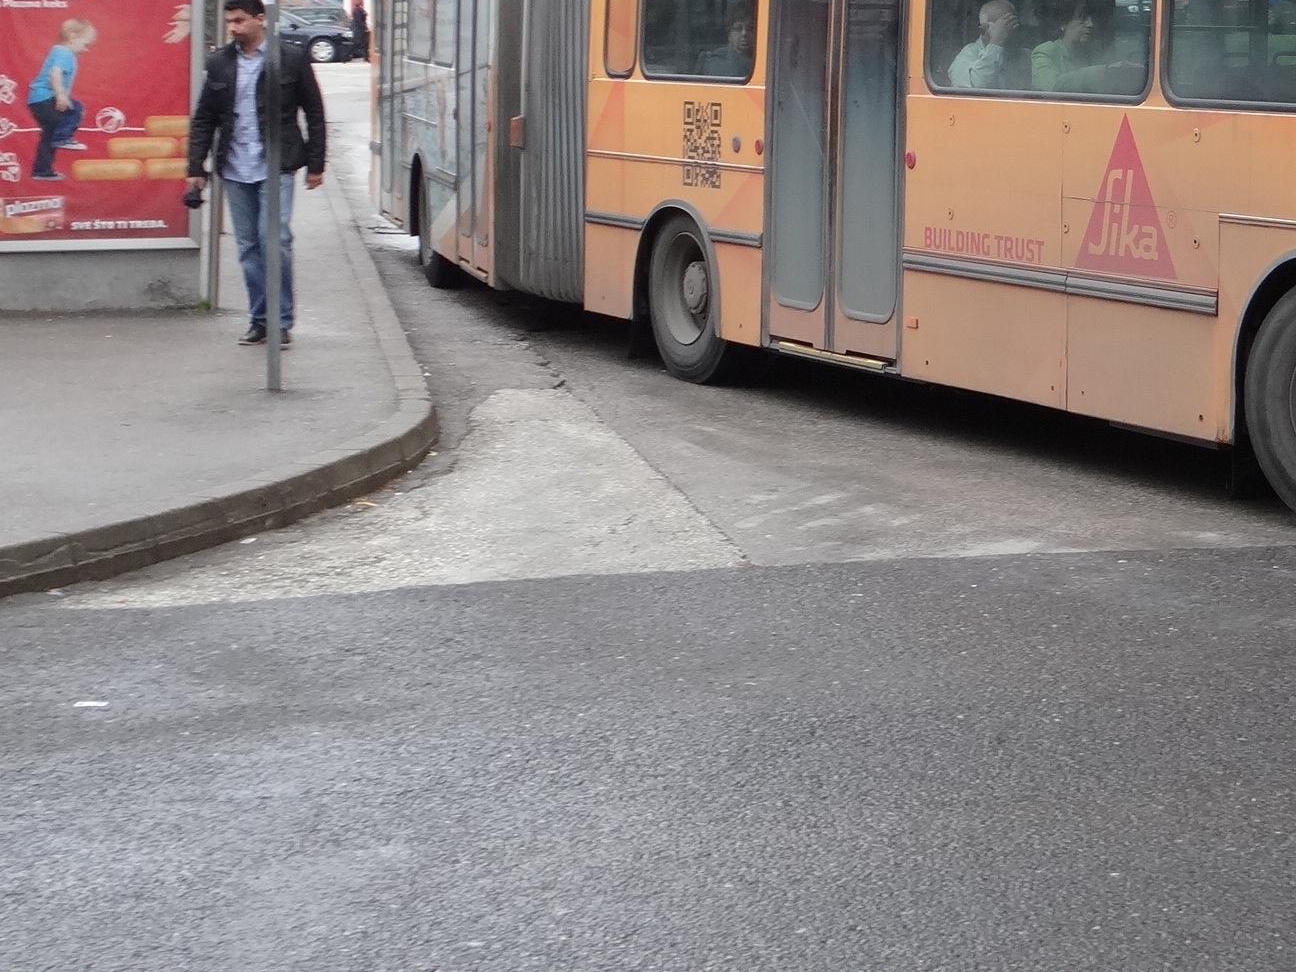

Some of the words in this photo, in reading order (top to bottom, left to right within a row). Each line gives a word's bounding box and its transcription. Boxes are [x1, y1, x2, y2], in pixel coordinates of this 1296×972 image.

[924, 226, 991, 254] BUILDING
[993, 234, 1045, 264] TRUST
[1088, 169, 1159, 261] Sika
